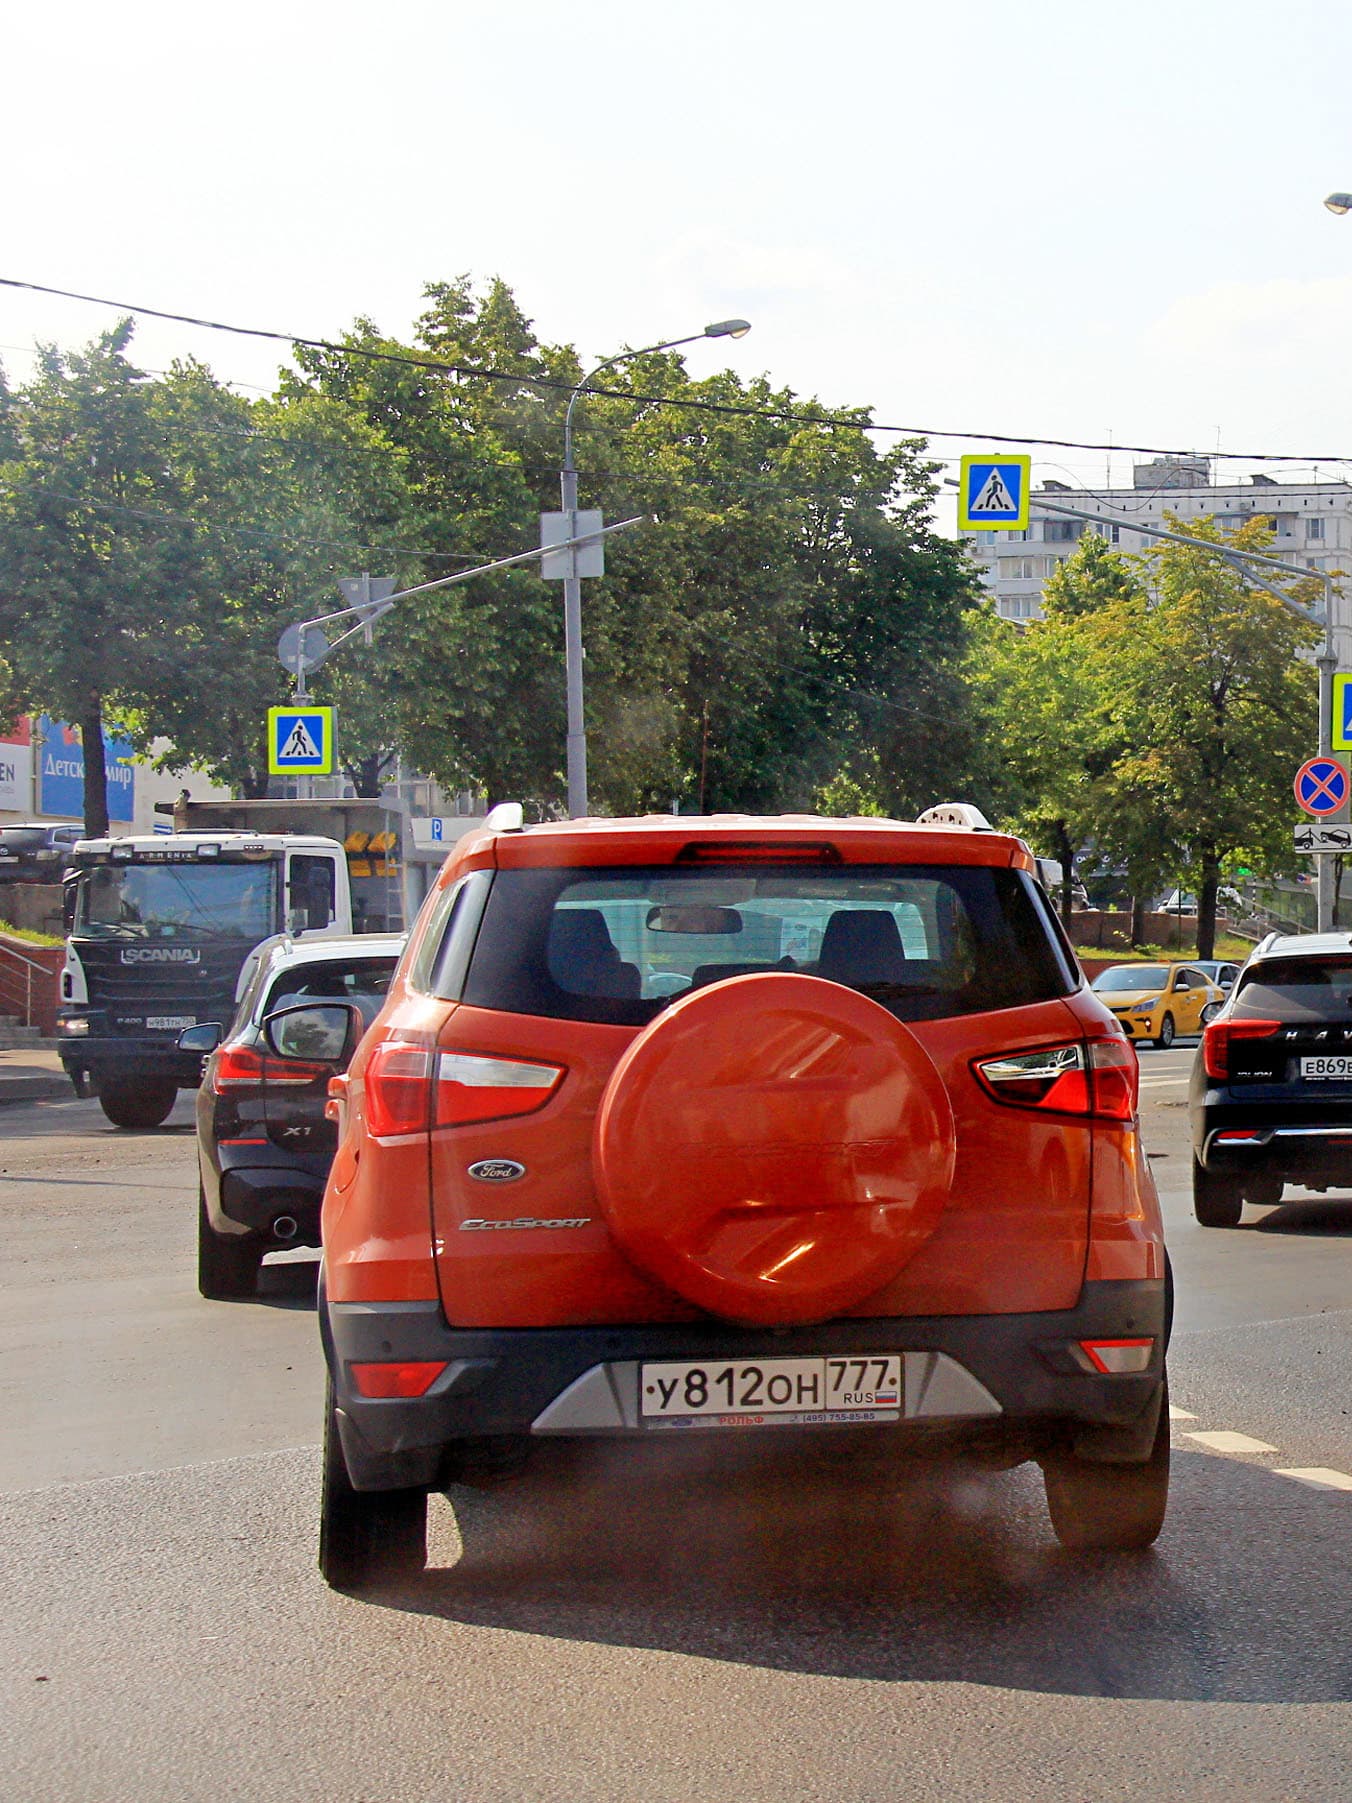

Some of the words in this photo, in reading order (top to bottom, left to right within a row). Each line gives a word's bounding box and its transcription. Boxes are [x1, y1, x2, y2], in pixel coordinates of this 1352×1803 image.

[44, 753, 85, 779] Детск
[106, 763, 132, 790] мир
[139, 852, 193, 860] ARMENIA
[125, 949, 195, 962] SCANIA
[283, 1127, 312, 1136] X1
[480, 1163, 512, 1178] Ford
[829, 1360, 889, 1392] 777
[843, 1393, 874, 1404] RUS
[719, 1416, 764, 1425] РОЛЬФ
[803, 1413, 827, 1422] (495)
